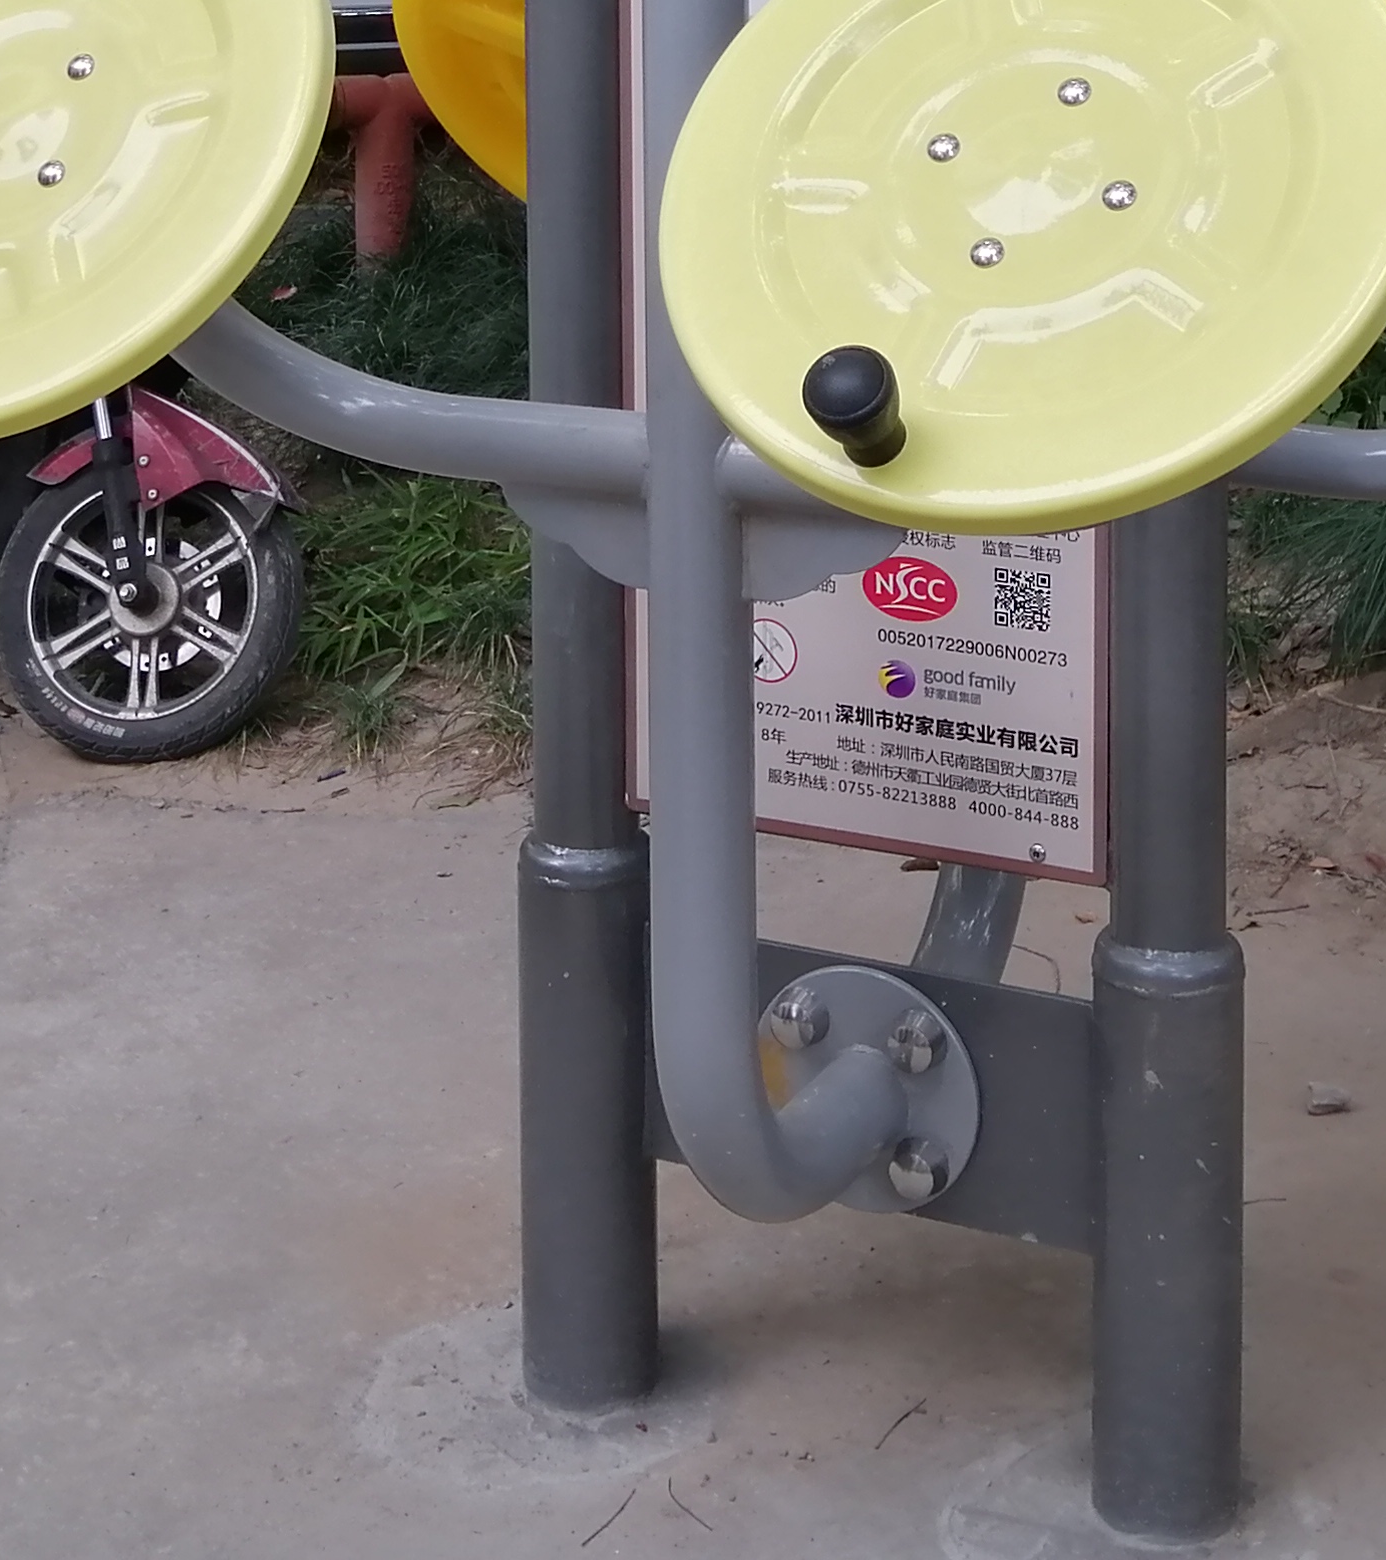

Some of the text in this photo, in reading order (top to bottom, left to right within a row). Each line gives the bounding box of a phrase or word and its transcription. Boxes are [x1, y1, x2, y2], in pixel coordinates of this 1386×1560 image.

[982, 539, 1062, 565] 监管二维码
[874, 562, 946, 604] NSCC
[877, 627, 1068, 668] 0052017229006N00273
[923, 686, 982, 706] 好家庭集团
[924, 667, 1016, 696] good family
[761, 727, 787, 745] 8年
[835, 703, 1079, 759] 深圳市好家庭实业有限公司
[968, 800, 1080, 831] 4000-844-888
